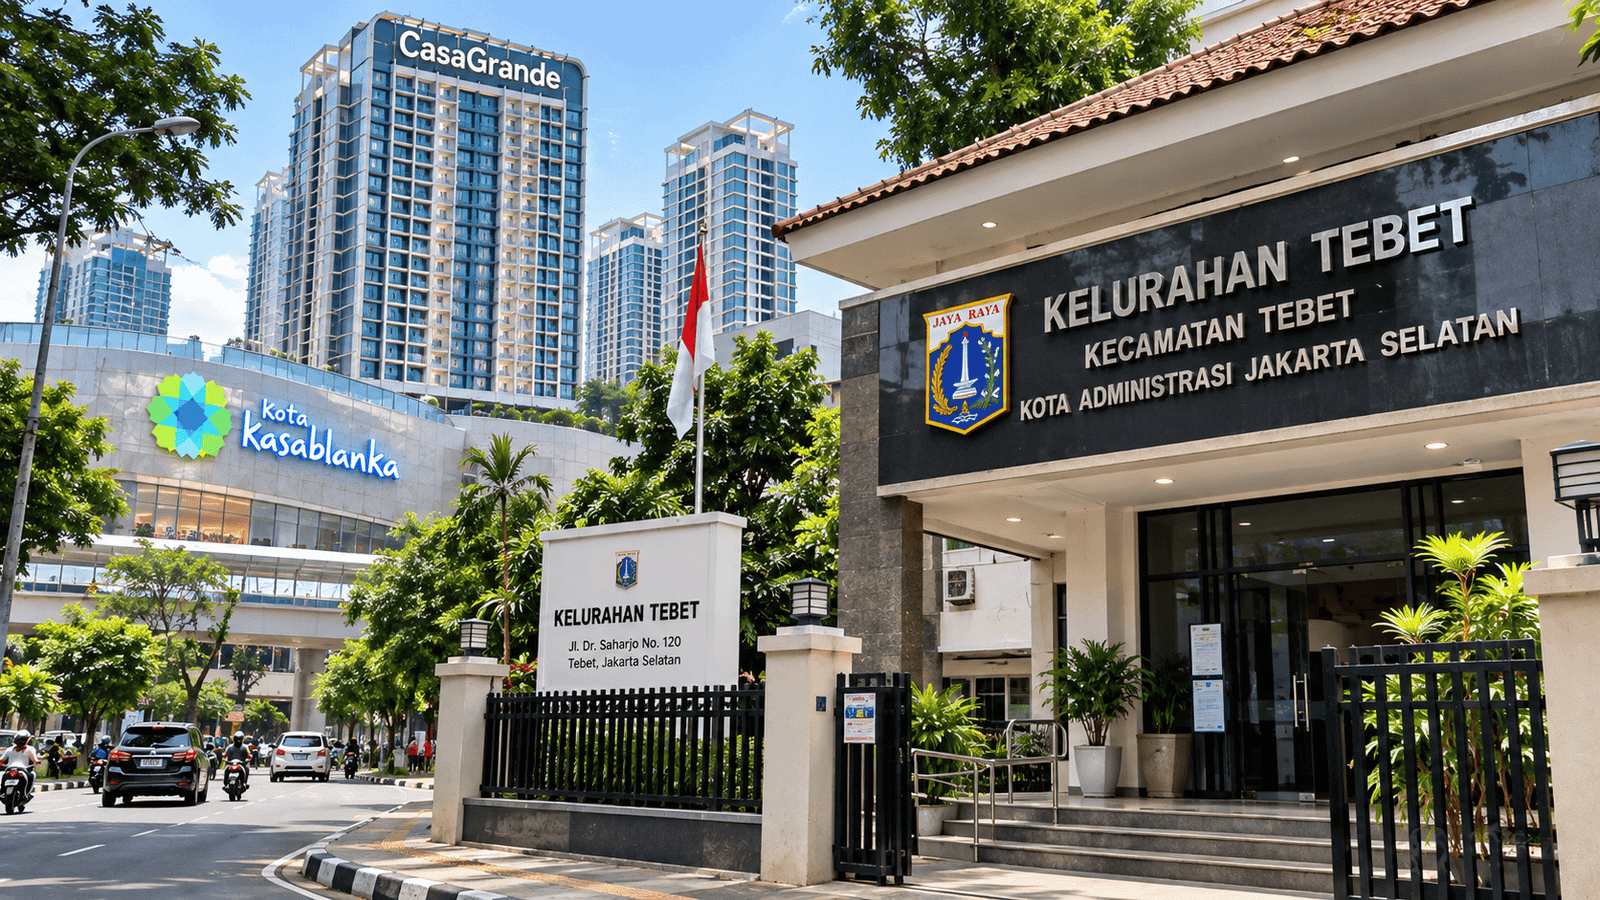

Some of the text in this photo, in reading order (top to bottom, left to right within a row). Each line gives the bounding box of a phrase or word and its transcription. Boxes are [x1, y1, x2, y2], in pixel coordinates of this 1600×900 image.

[399, 30, 562, 90] CasaGrande
[1043, 195, 1476, 334] KELURAHAN TEBET
[932, 304, 1000, 329] JAYA RAYA
[1083, 288, 1356, 370] KECAMATAN TEBET
[1020, 306, 1521, 422] KOTA ADMINISTRASI JAKARTA SELATAN
[261, 397, 309, 429] Kota
[240, 408, 401, 480] Kasablanka
[553, 600, 700, 627] KELURAHAN TEBET
[568, 635, 682, 653] Jl. Dr. Saharjo No. 120
[568, 654, 681, 670] Tebet, Jakarta Selatan
